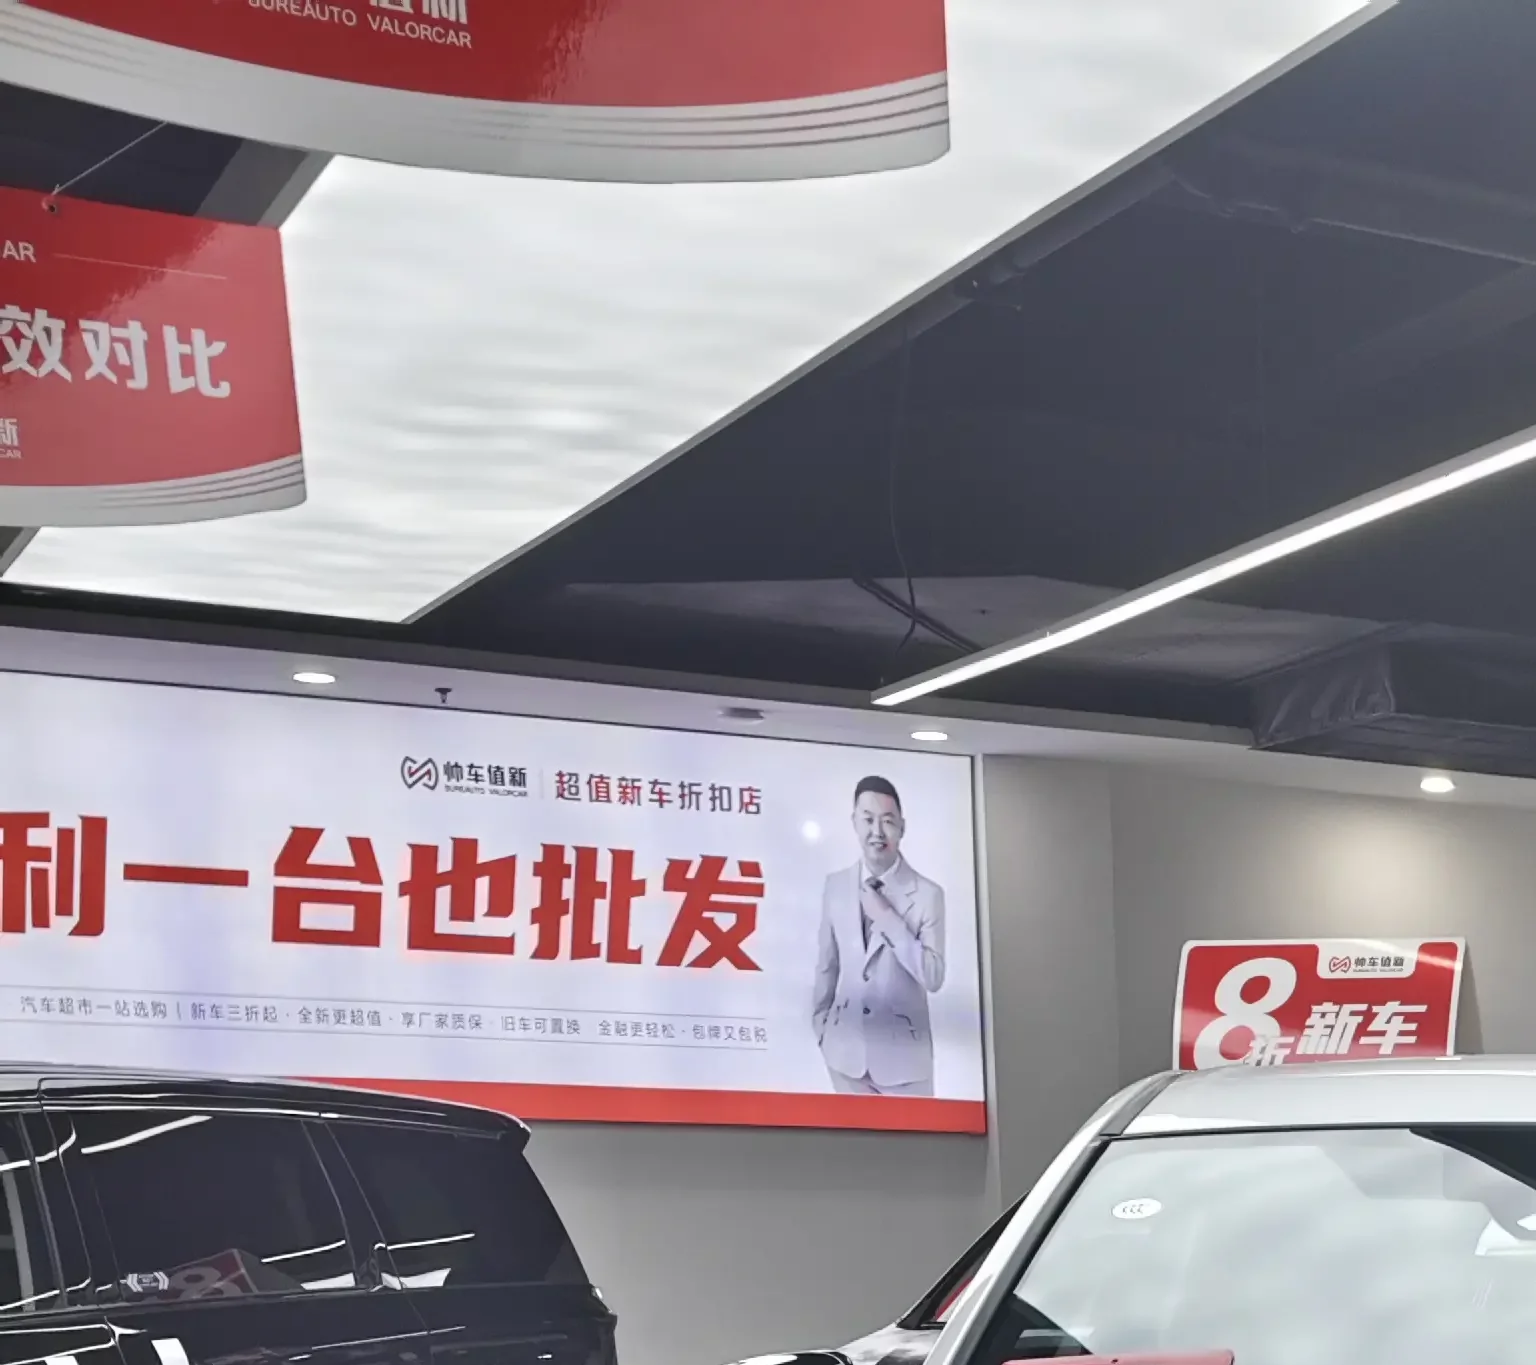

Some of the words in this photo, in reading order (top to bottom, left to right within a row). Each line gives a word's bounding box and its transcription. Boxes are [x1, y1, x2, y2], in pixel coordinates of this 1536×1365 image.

[366, 12, 472, 49] VALORCAR
[0, 303, 231, 399] 效对比
[443, 761, 528, 788] 帅车值新
[555, 770, 762, 815] 超值新车折扣店
[0, 808, 765, 972] 利一台也批发
[190, 1002, 279, 1022] 新车三折起
[297, 1006, 382, 1027] 全新更超值
[401, 1011, 483, 1030] 享厂家质保
[599, 1019, 676, 1039] 金融更轻松
